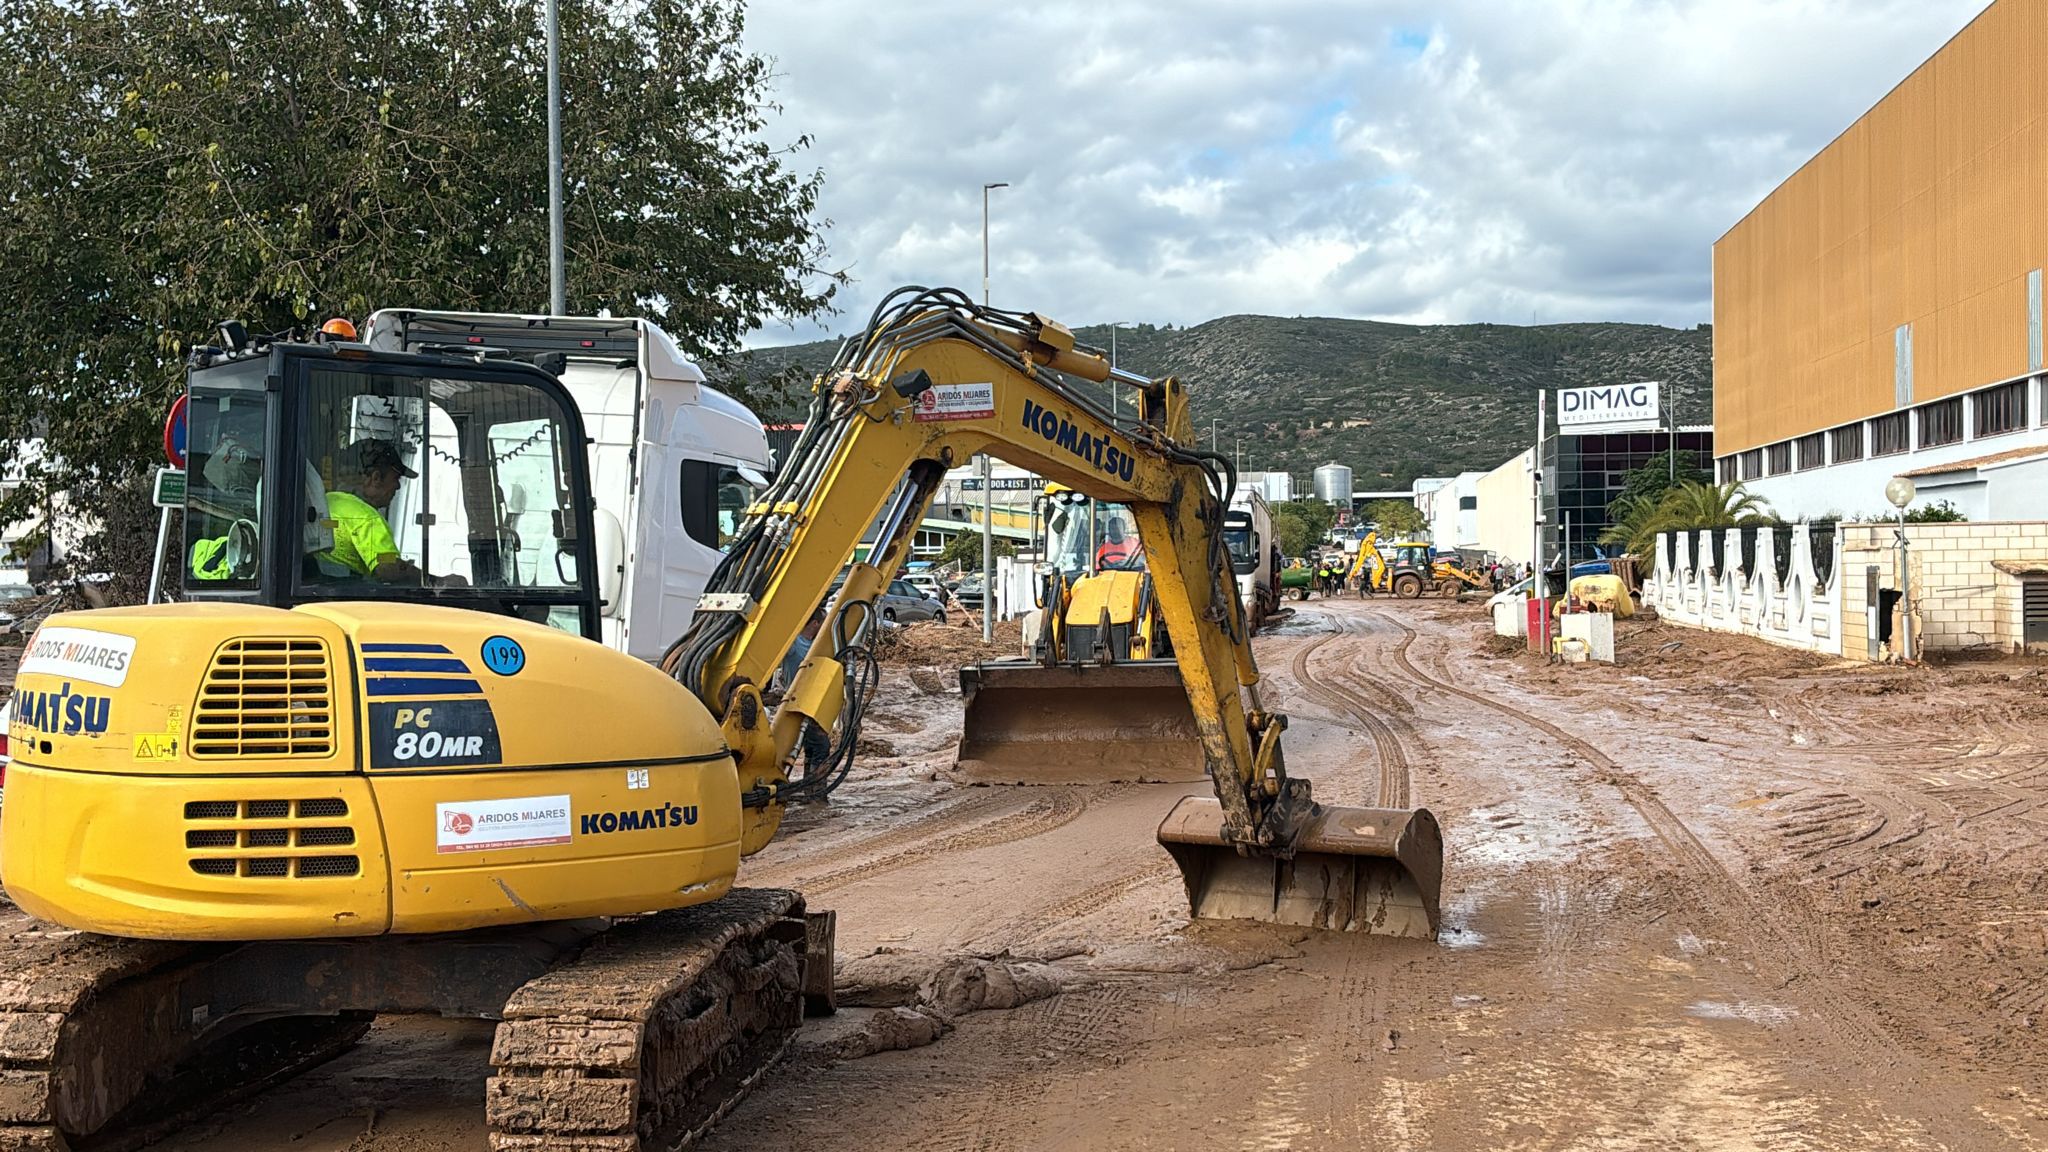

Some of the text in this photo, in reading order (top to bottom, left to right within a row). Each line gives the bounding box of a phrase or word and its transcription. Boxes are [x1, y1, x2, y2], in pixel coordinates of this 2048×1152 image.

[938, 390, 990, 400] ARIDOS MIJARES
[1563, 386, 1648, 411] DIMAG
[1022, 399, 1135, 482] KOMATSU
[63, 642, 128, 671] MIJARES
[491, 646, 519, 665] 199
[10, 682, 111, 736] OMATSU
[394, 707, 433, 729] PC
[393, 731, 484, 760] 80MR
[478, 808, 566, 824] ARIDOS MIJARES
[581, 802, 698, 834] KOMATSU
